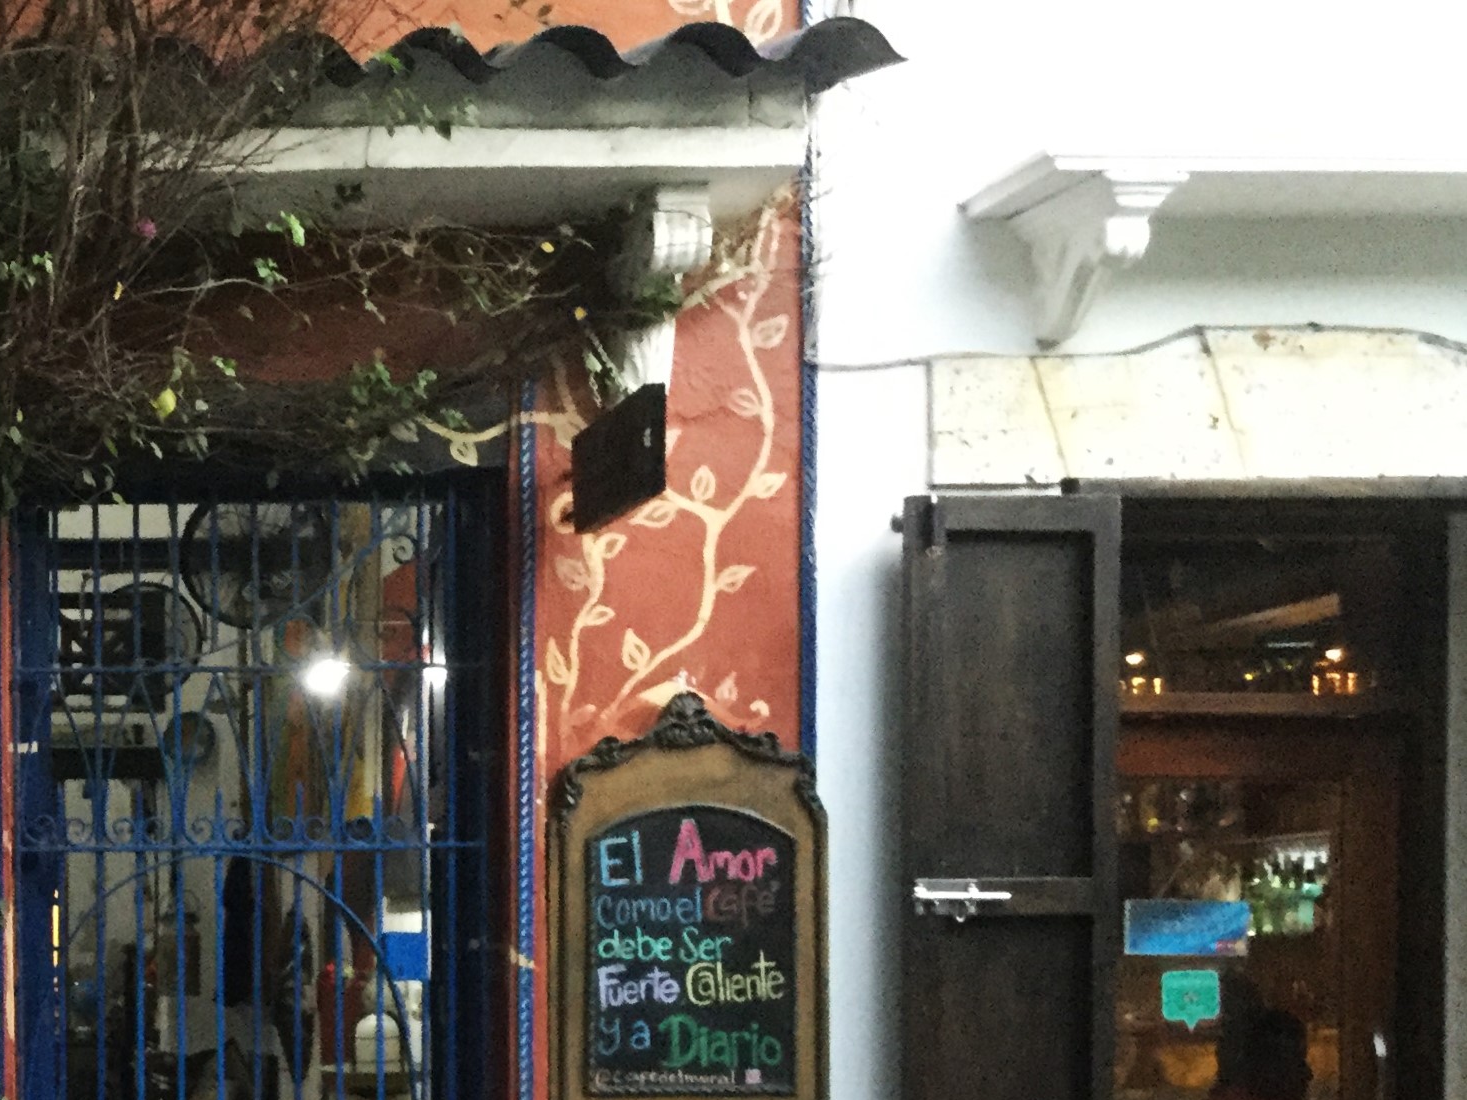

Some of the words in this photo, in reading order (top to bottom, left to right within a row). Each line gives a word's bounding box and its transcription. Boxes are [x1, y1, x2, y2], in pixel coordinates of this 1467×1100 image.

[598, 829, 644, 887] El
[669, 817, 779, 886] Amor
[675, 887, 703, 923] el
[597, 926, 673, 960] debe
[597, 963, 681, 1012] Fuerte
[685, 949, 786, 1007] Caliente
[629, 1021, 652, 1049] a
[657, 1013, 783, 1070] Diario
